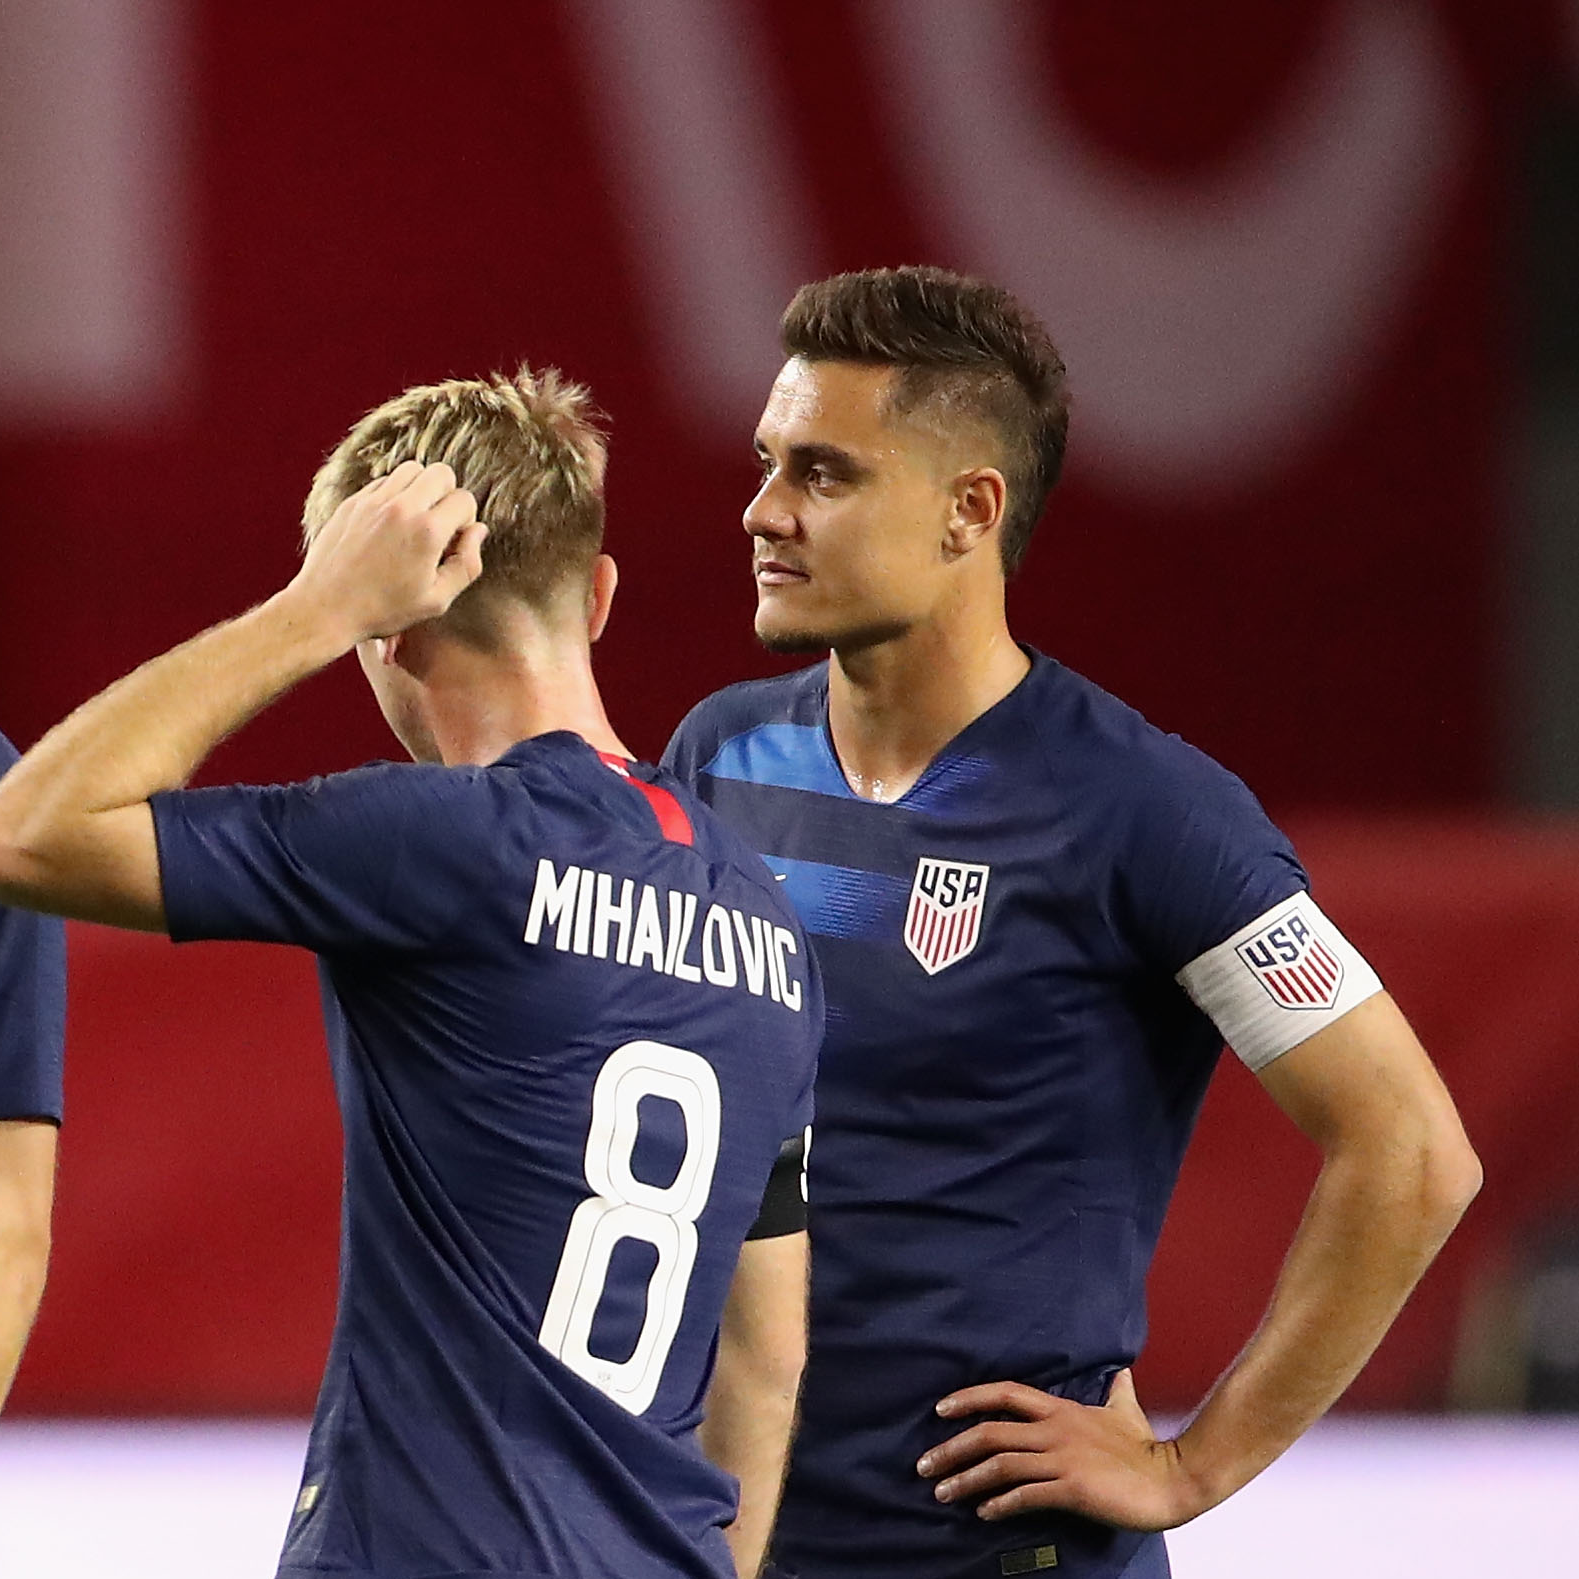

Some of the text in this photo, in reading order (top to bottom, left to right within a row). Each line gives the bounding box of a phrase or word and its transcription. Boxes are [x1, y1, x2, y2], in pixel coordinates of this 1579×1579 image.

[524, 858, 802, 1012] MIHAILOVIC
[919, 864, 983, 908] USA
[1244, 915, 1310, 968] USA
[537, 1040, 722, 1417] 8
